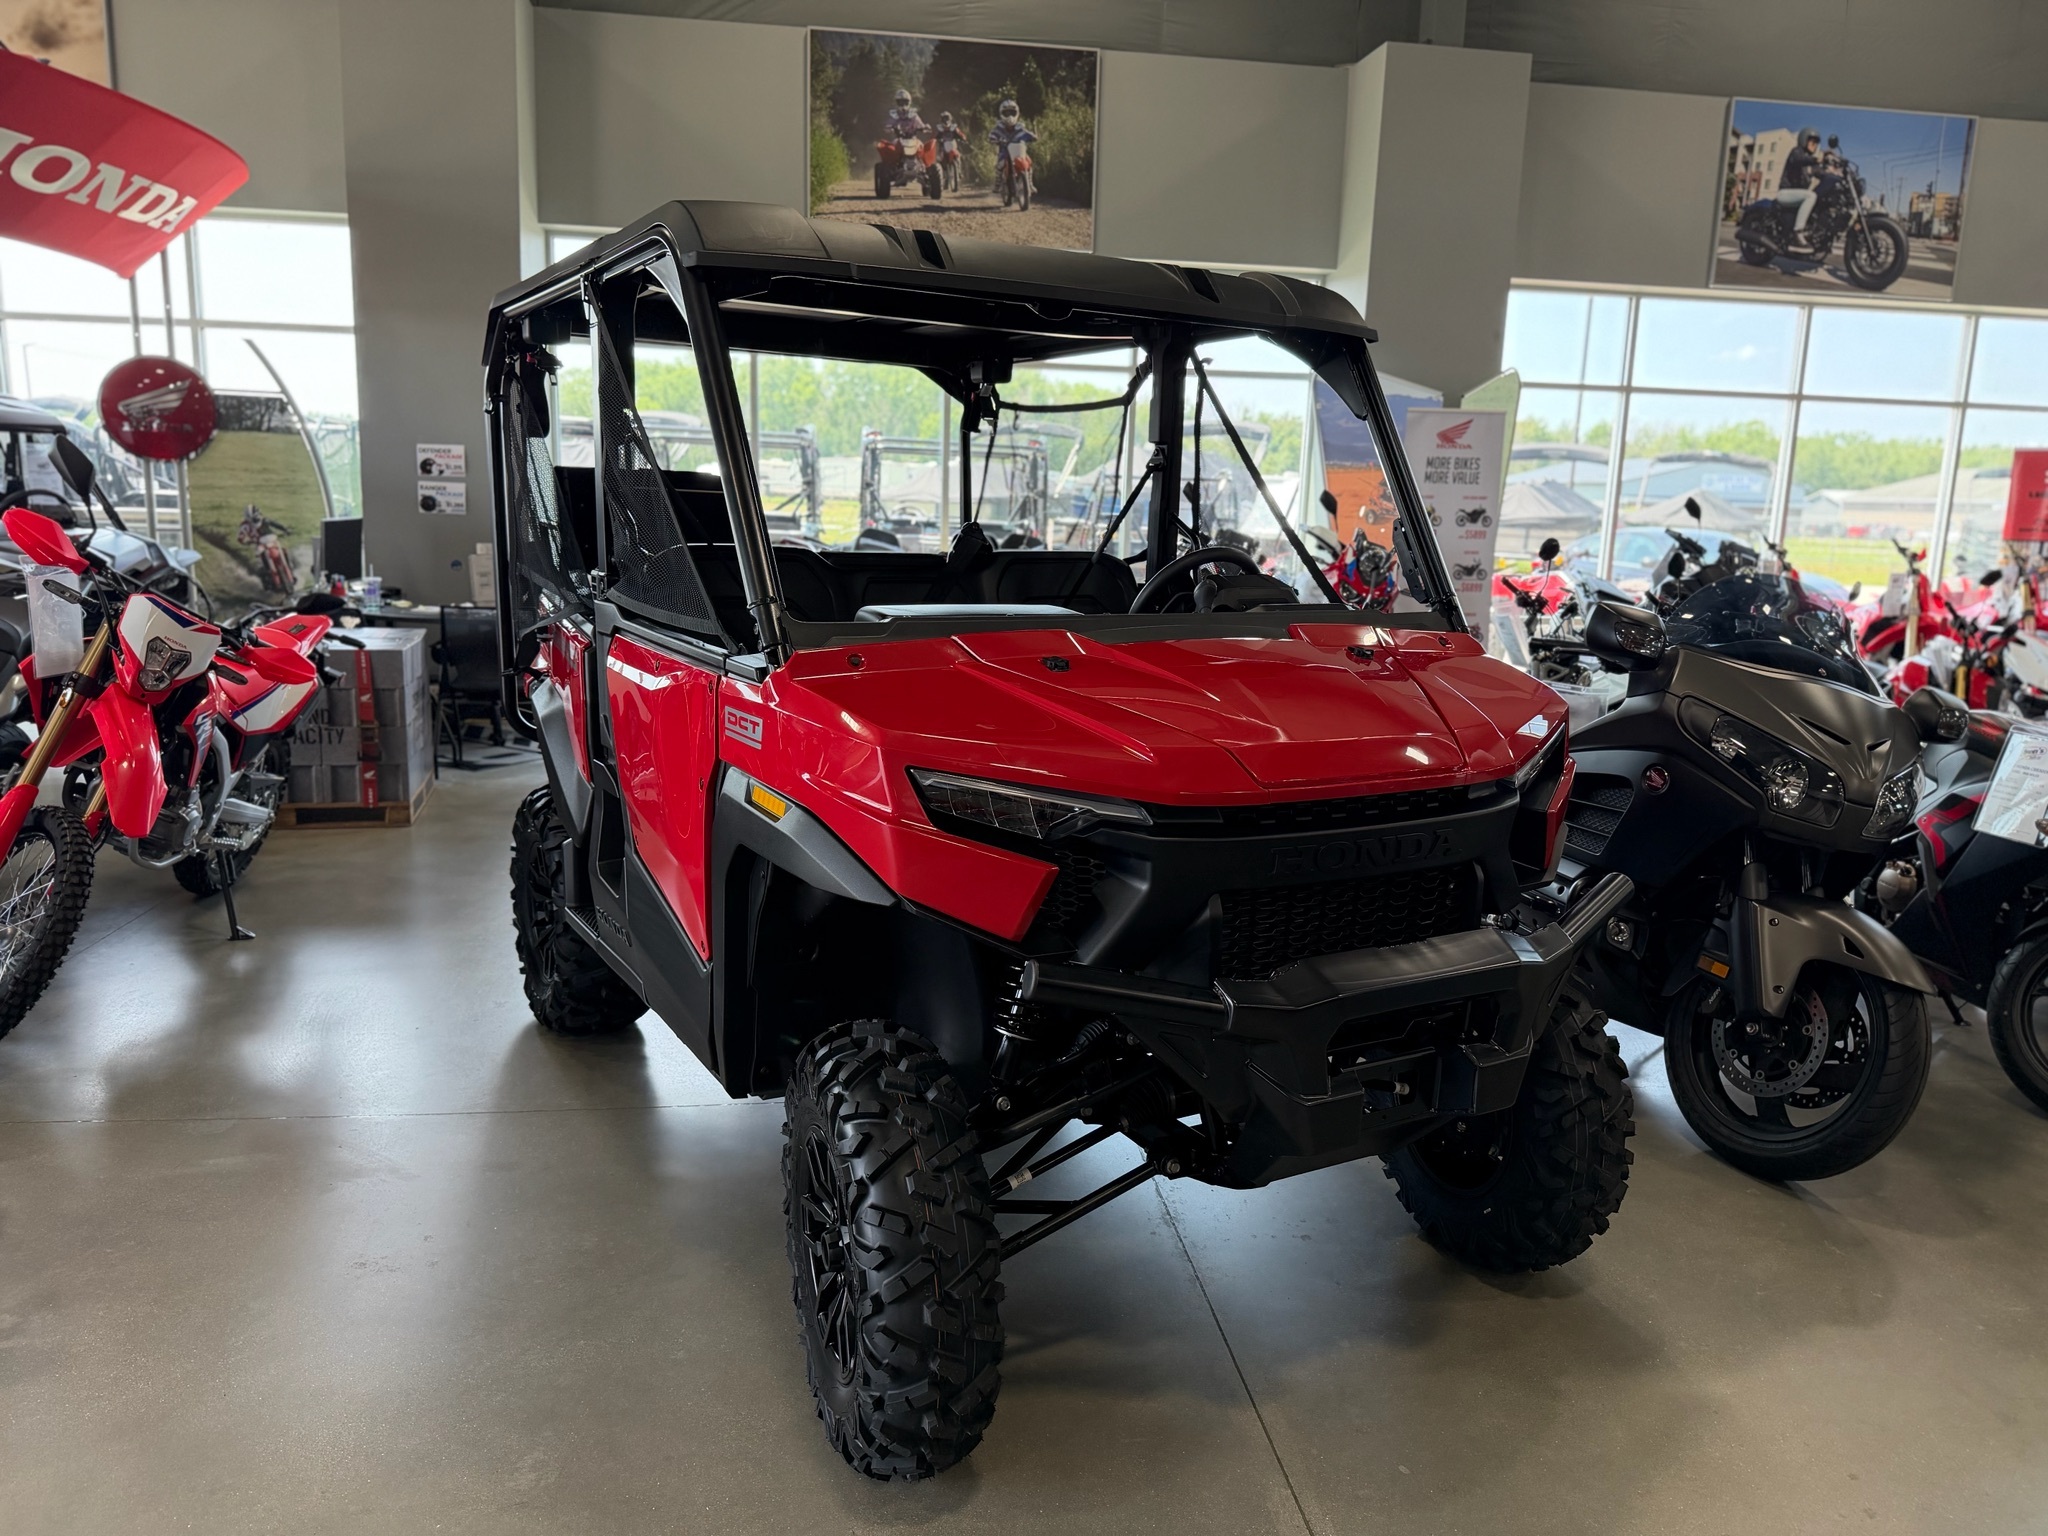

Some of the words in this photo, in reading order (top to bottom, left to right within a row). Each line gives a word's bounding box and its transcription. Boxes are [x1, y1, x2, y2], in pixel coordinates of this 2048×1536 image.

[1426, 457, 1451, 470] MORE
[1453, 457, 1480, 470] BIKES
[1424, 471, 1450, 484] MORE
[1452, 472, 1479, 485] VALUE
[164, 635, 187, 650] HONDA
[727, 711, 760, 735] DCT
[293, 725, 344, 745] ACITY
[1270, 829, 1462, 875] HONDA
